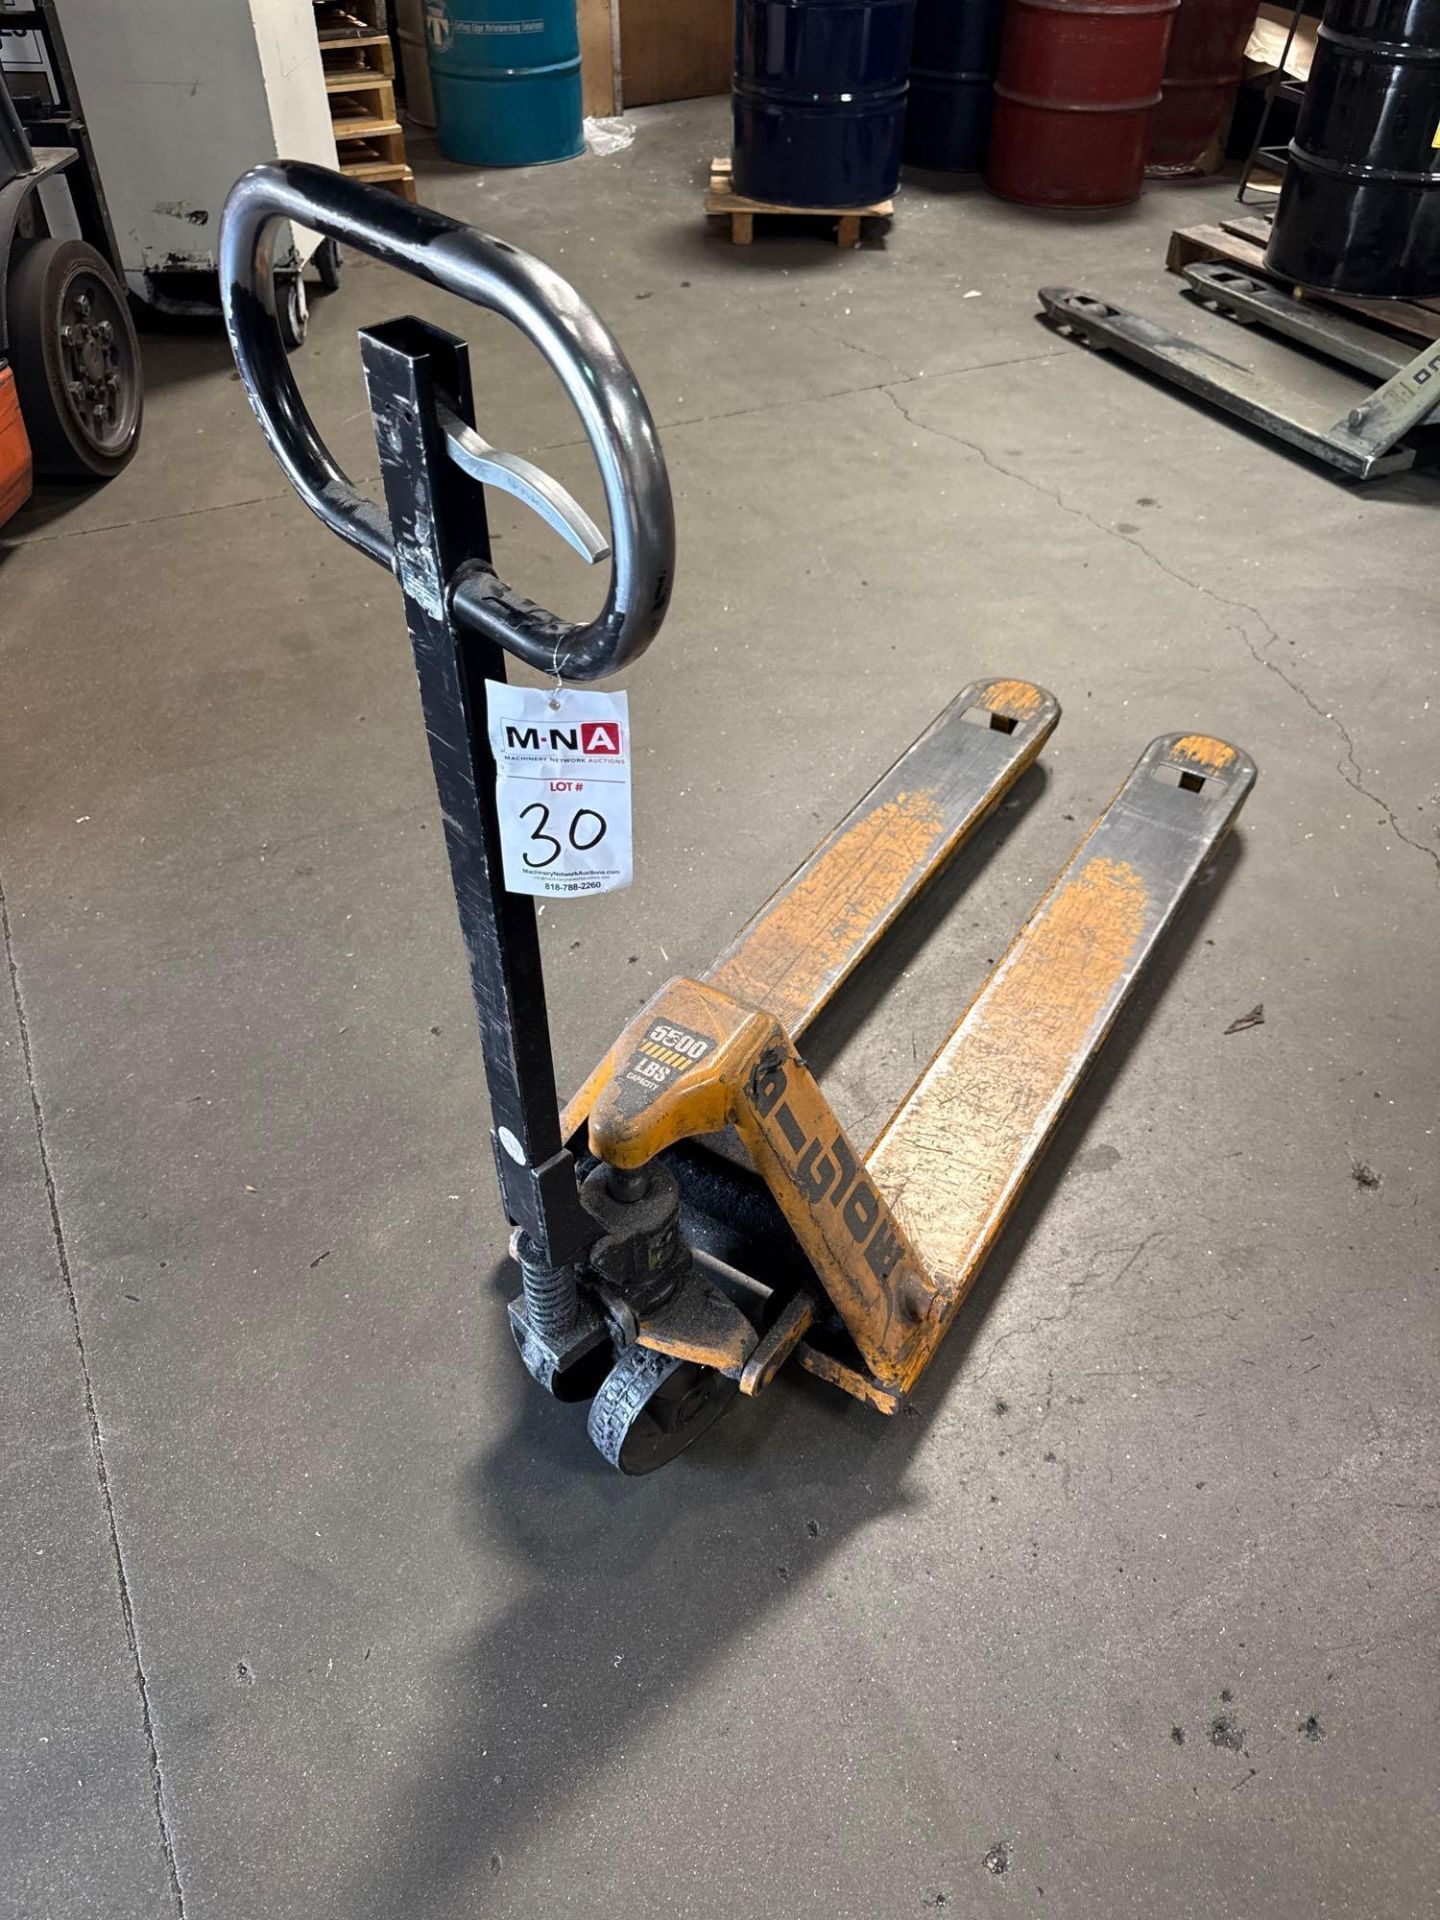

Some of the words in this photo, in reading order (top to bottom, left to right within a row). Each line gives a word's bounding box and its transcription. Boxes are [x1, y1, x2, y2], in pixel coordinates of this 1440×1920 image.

[588, 757, 625, 765] AUCTIONS
[550, 782, 573, 793] LOT
[575, 783, 584, 793] #
[519, 802, 608, 868] 30
[544, 881, 602, 892] 818-788-2260
[650, 1025, 709, 1059] 5500
[633, 1057, 671, 1082] LBS
[625, 1071, 661, 1091] CAPACITY
